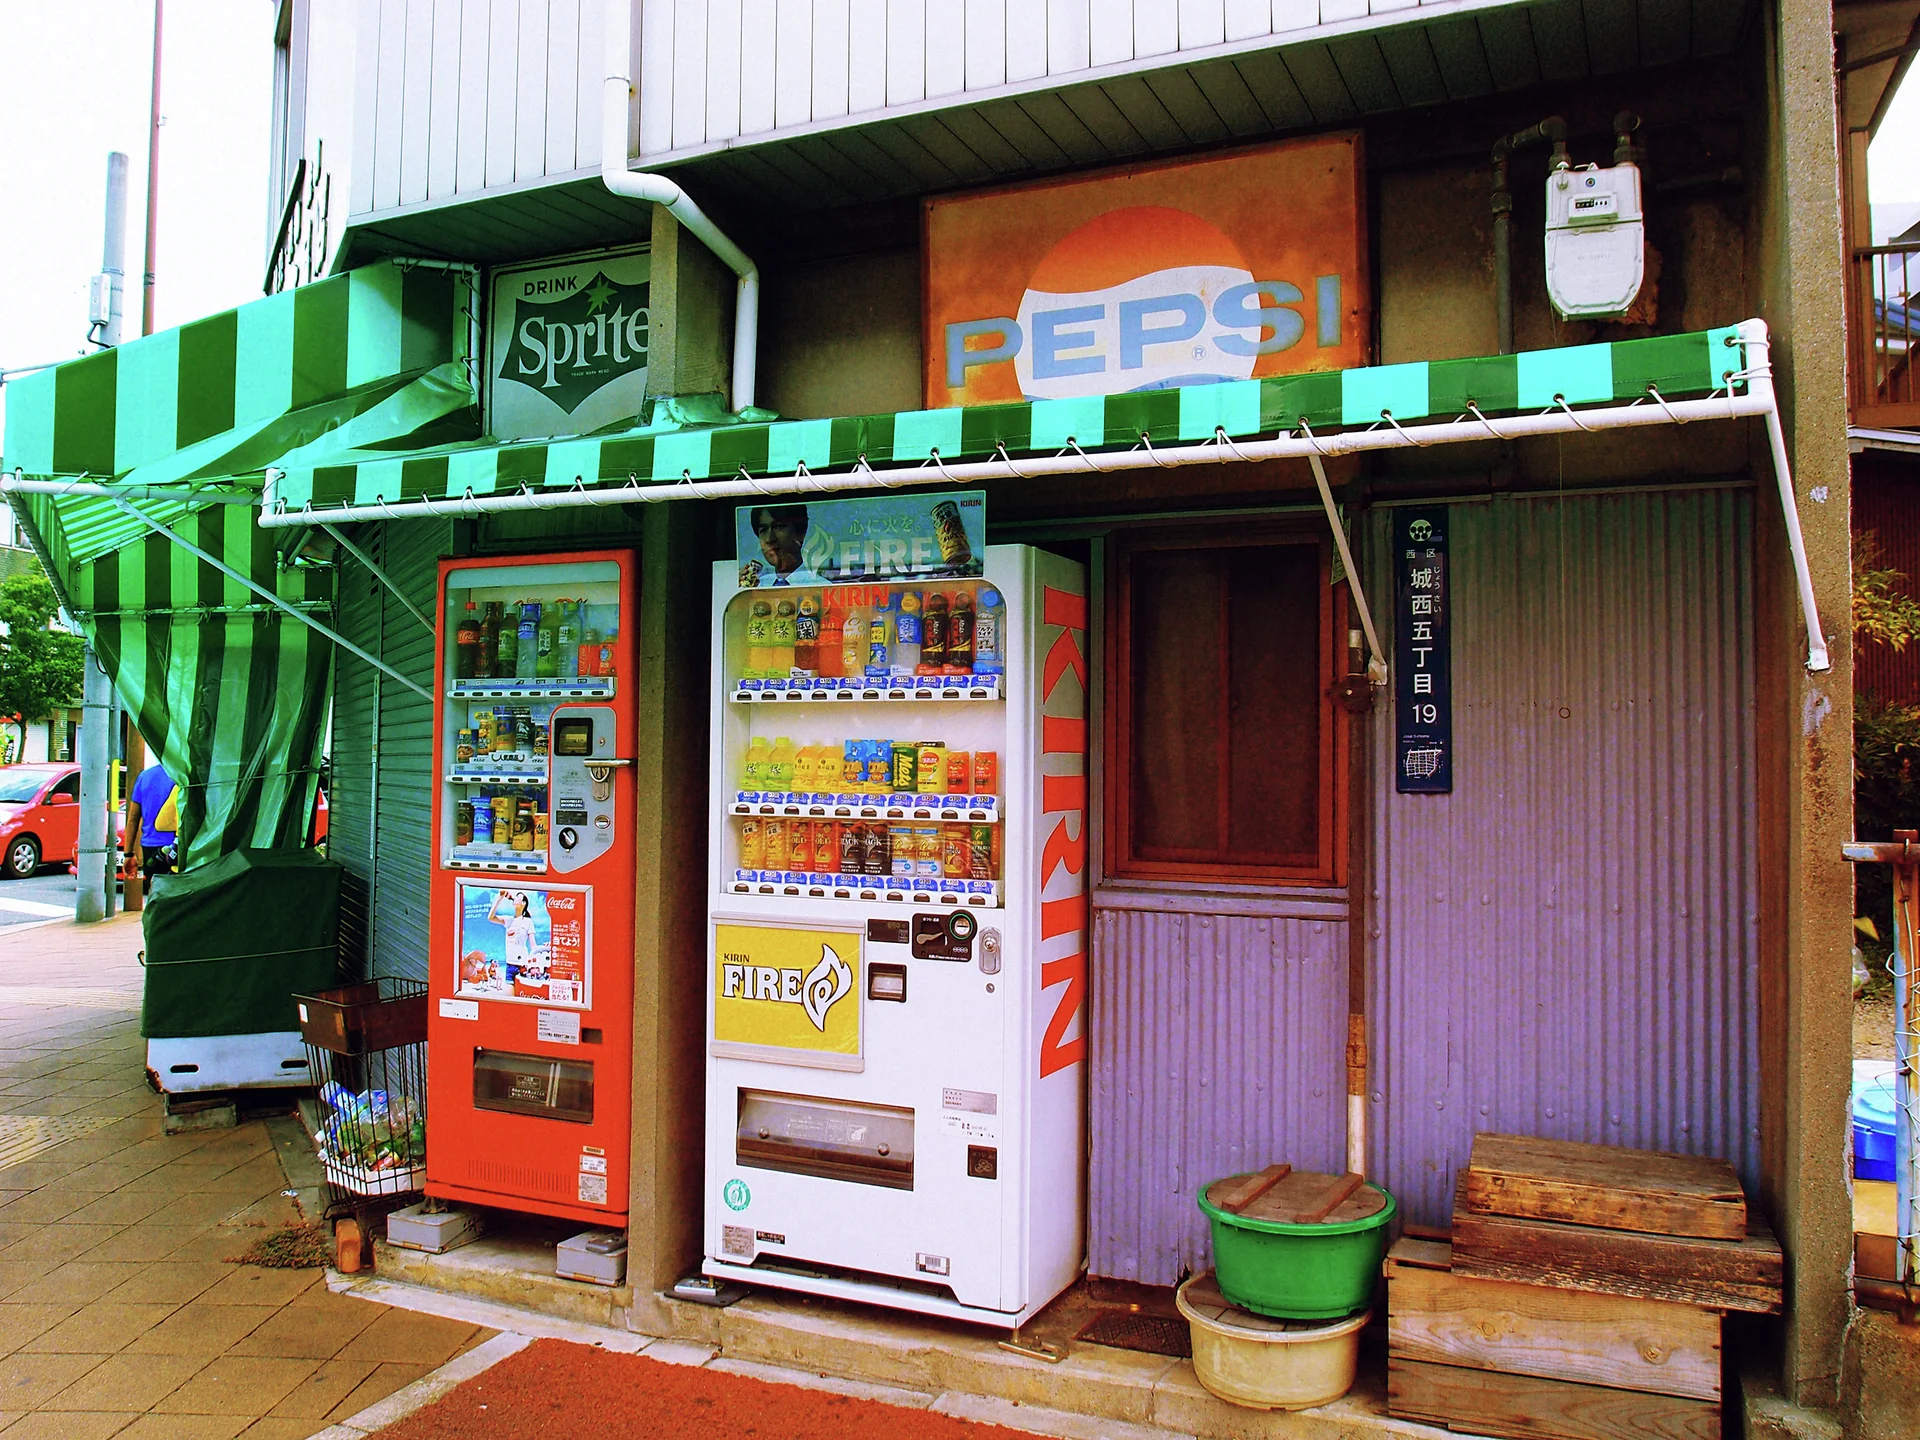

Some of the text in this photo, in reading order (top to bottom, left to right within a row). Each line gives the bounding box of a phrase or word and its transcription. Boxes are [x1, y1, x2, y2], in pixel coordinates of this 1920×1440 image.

[523, 275, 579, 297] DRINK
[518, 302, 650, 389] Sprite
[945, 274, 1342, 389] PEPSI
[960, 499, 982, 508] KIRIN
[850, 516, 922, 536] 心に火を。
[839, 536, 934, 576] FIRE
[822, 585, 889, 608] KIRIN
[1411, 567, 1437, 724] 城西五丁目 19
[898, 753, 913, 787] Mets
[1040, 585, 1088, 1079] KIRIN
[723, 952, 750, 963] KIRIN
[722, 963, 804, 1005] FIRE
